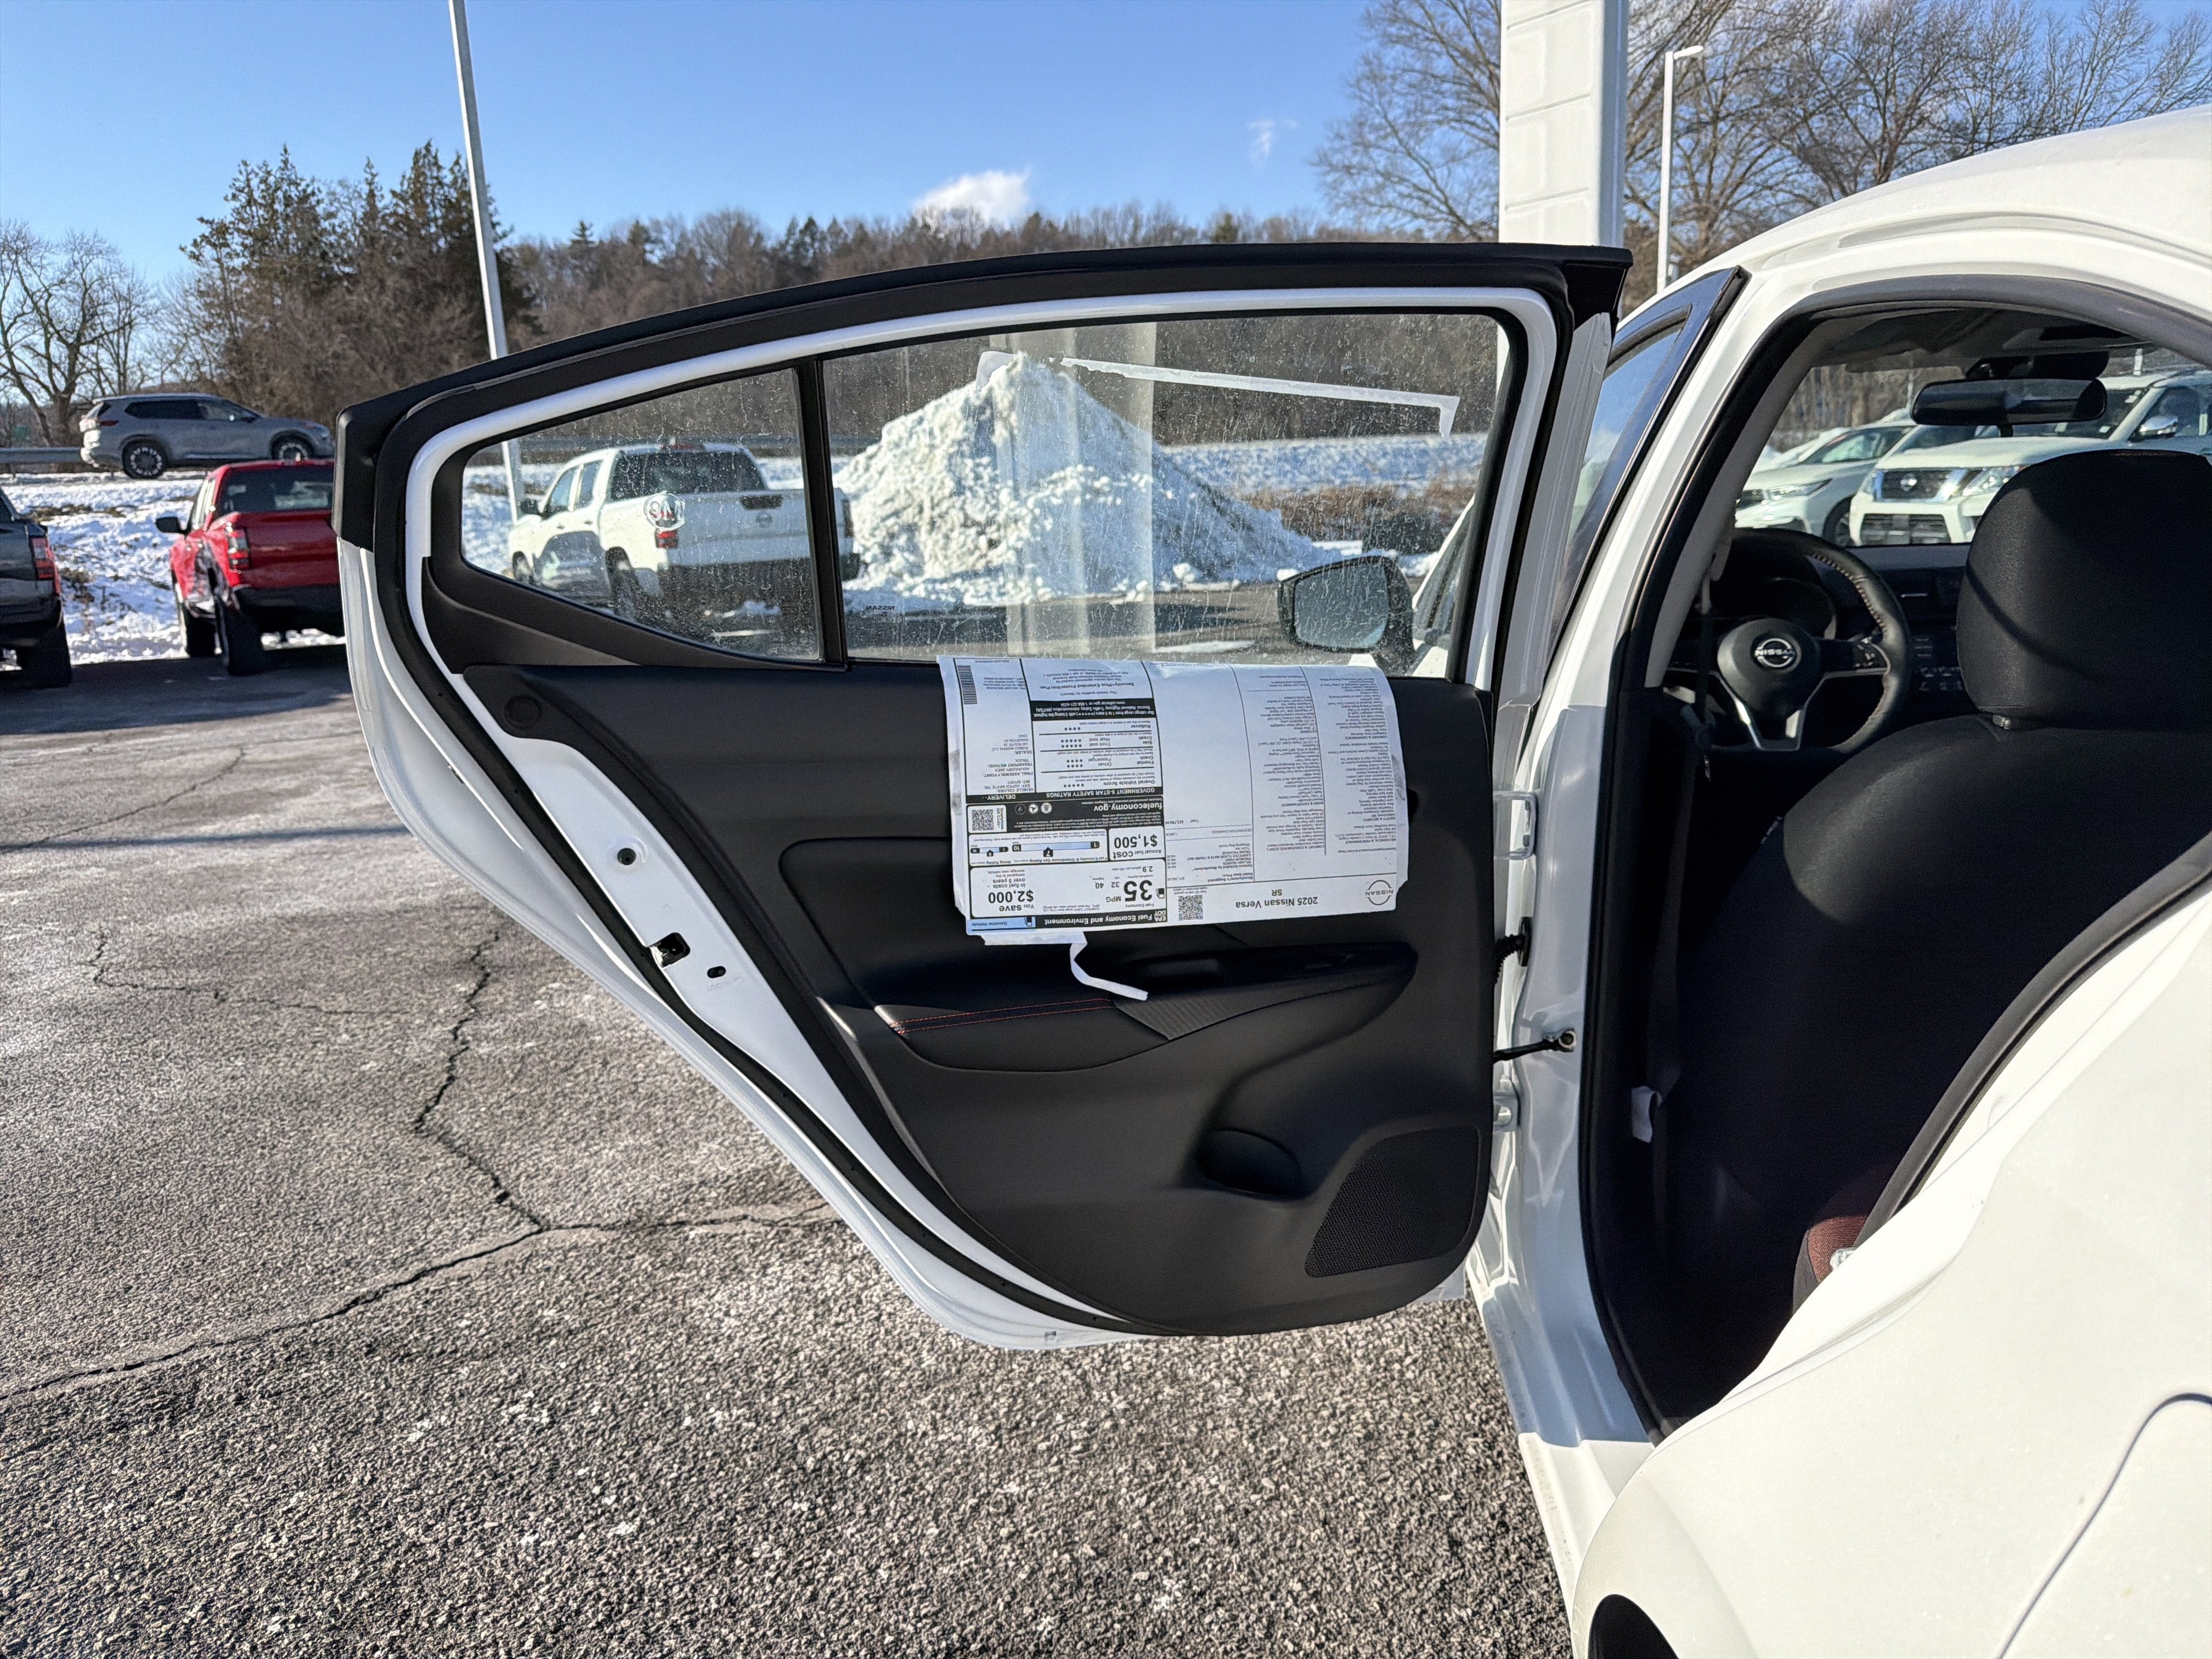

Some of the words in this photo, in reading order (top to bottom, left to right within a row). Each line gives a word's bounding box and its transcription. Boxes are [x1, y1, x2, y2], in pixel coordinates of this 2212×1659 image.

[1093, 802, 1162, 812] fueleconomy.gov
[1114, 834, 1158, 848] $1,500
[1113, 851, 1133, 859] cost
[1124, 880, 1152, 901] 35
[989, 890, 1034, 904] $2,000
[1265, 898, 1294, 906] Nissan
[1297, 897, 1318, 905] 2025
